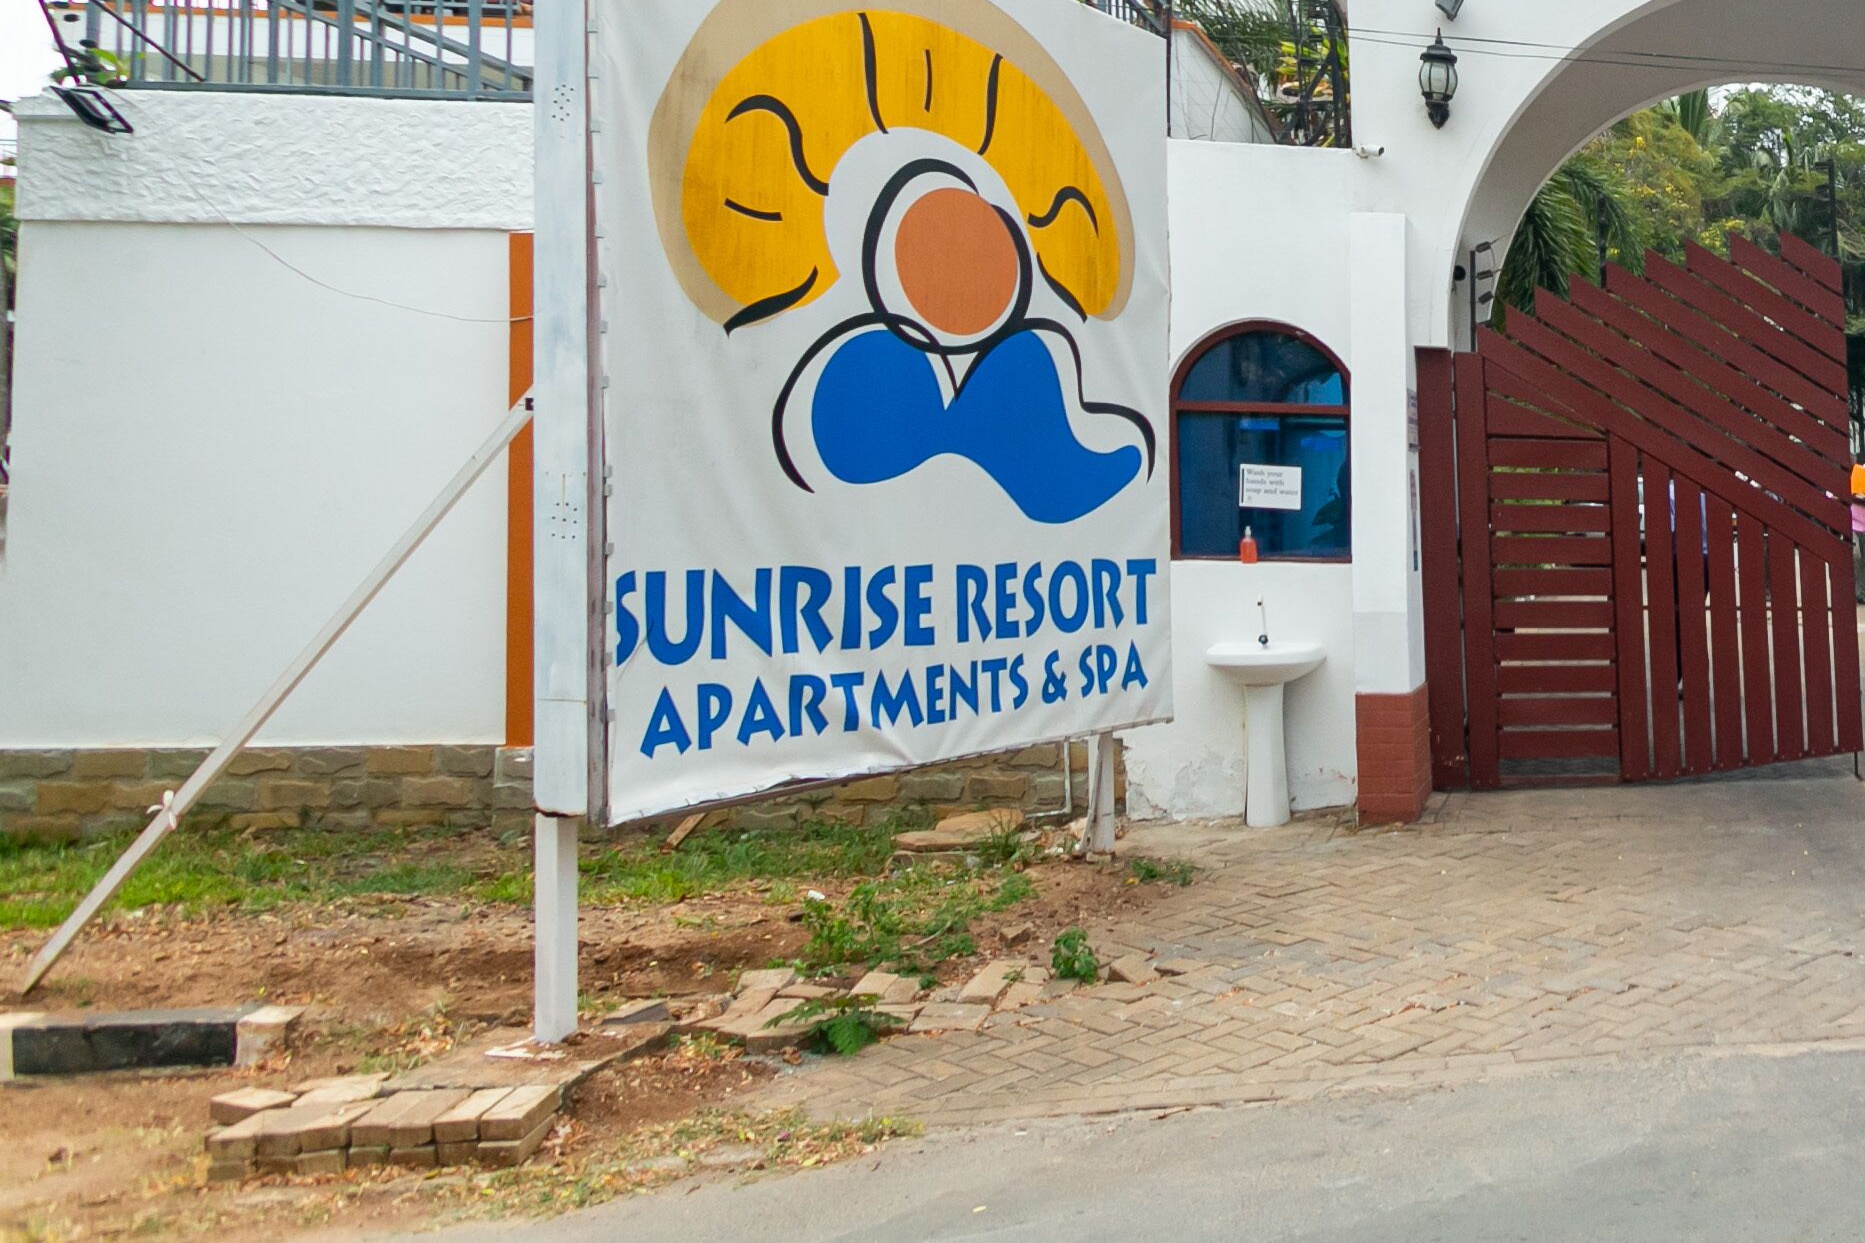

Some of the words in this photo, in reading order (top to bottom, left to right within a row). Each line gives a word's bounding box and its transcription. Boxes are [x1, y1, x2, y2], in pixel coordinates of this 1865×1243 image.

[614, 564, 936, 667] SUNRISE
[955, 558, 1158, 644] RESORT
[639, 659, 1030, 758] APARTMENTS
[1041, 650, 1067, 704] &
[1078, 641, 1149, 697] SPA
